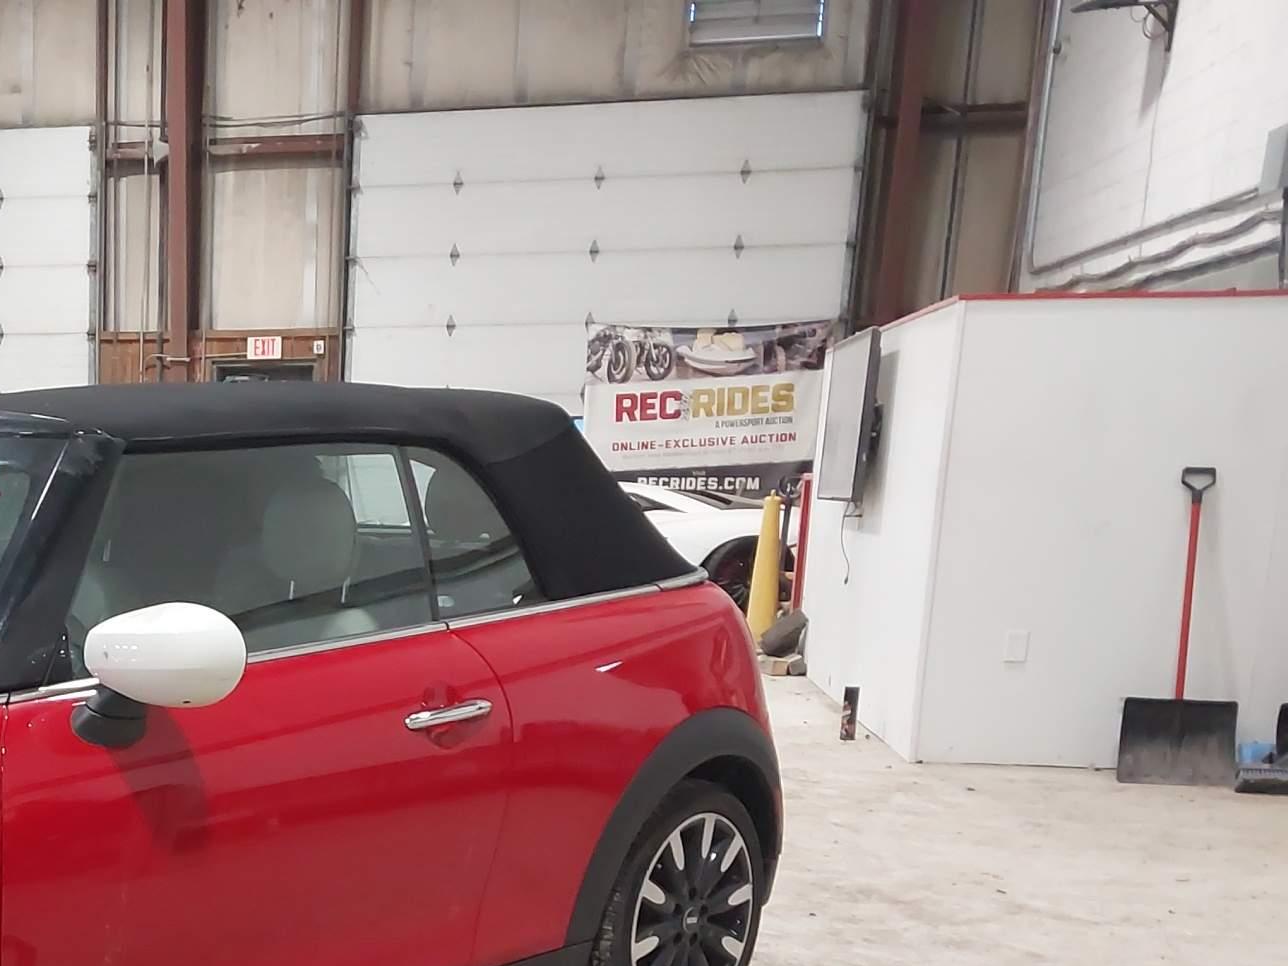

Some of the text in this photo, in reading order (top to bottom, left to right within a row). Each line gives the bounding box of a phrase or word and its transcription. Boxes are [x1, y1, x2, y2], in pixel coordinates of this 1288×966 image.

[253, 338, 277, 356] EXIT
[692, 382, 795, 418] RIDES
[765, 415, 793, 425] AUCTION
[612, 435, 736, 452] ONLINE-EXCLUSIVE
[741, 431, 797, 445] AUCTION
